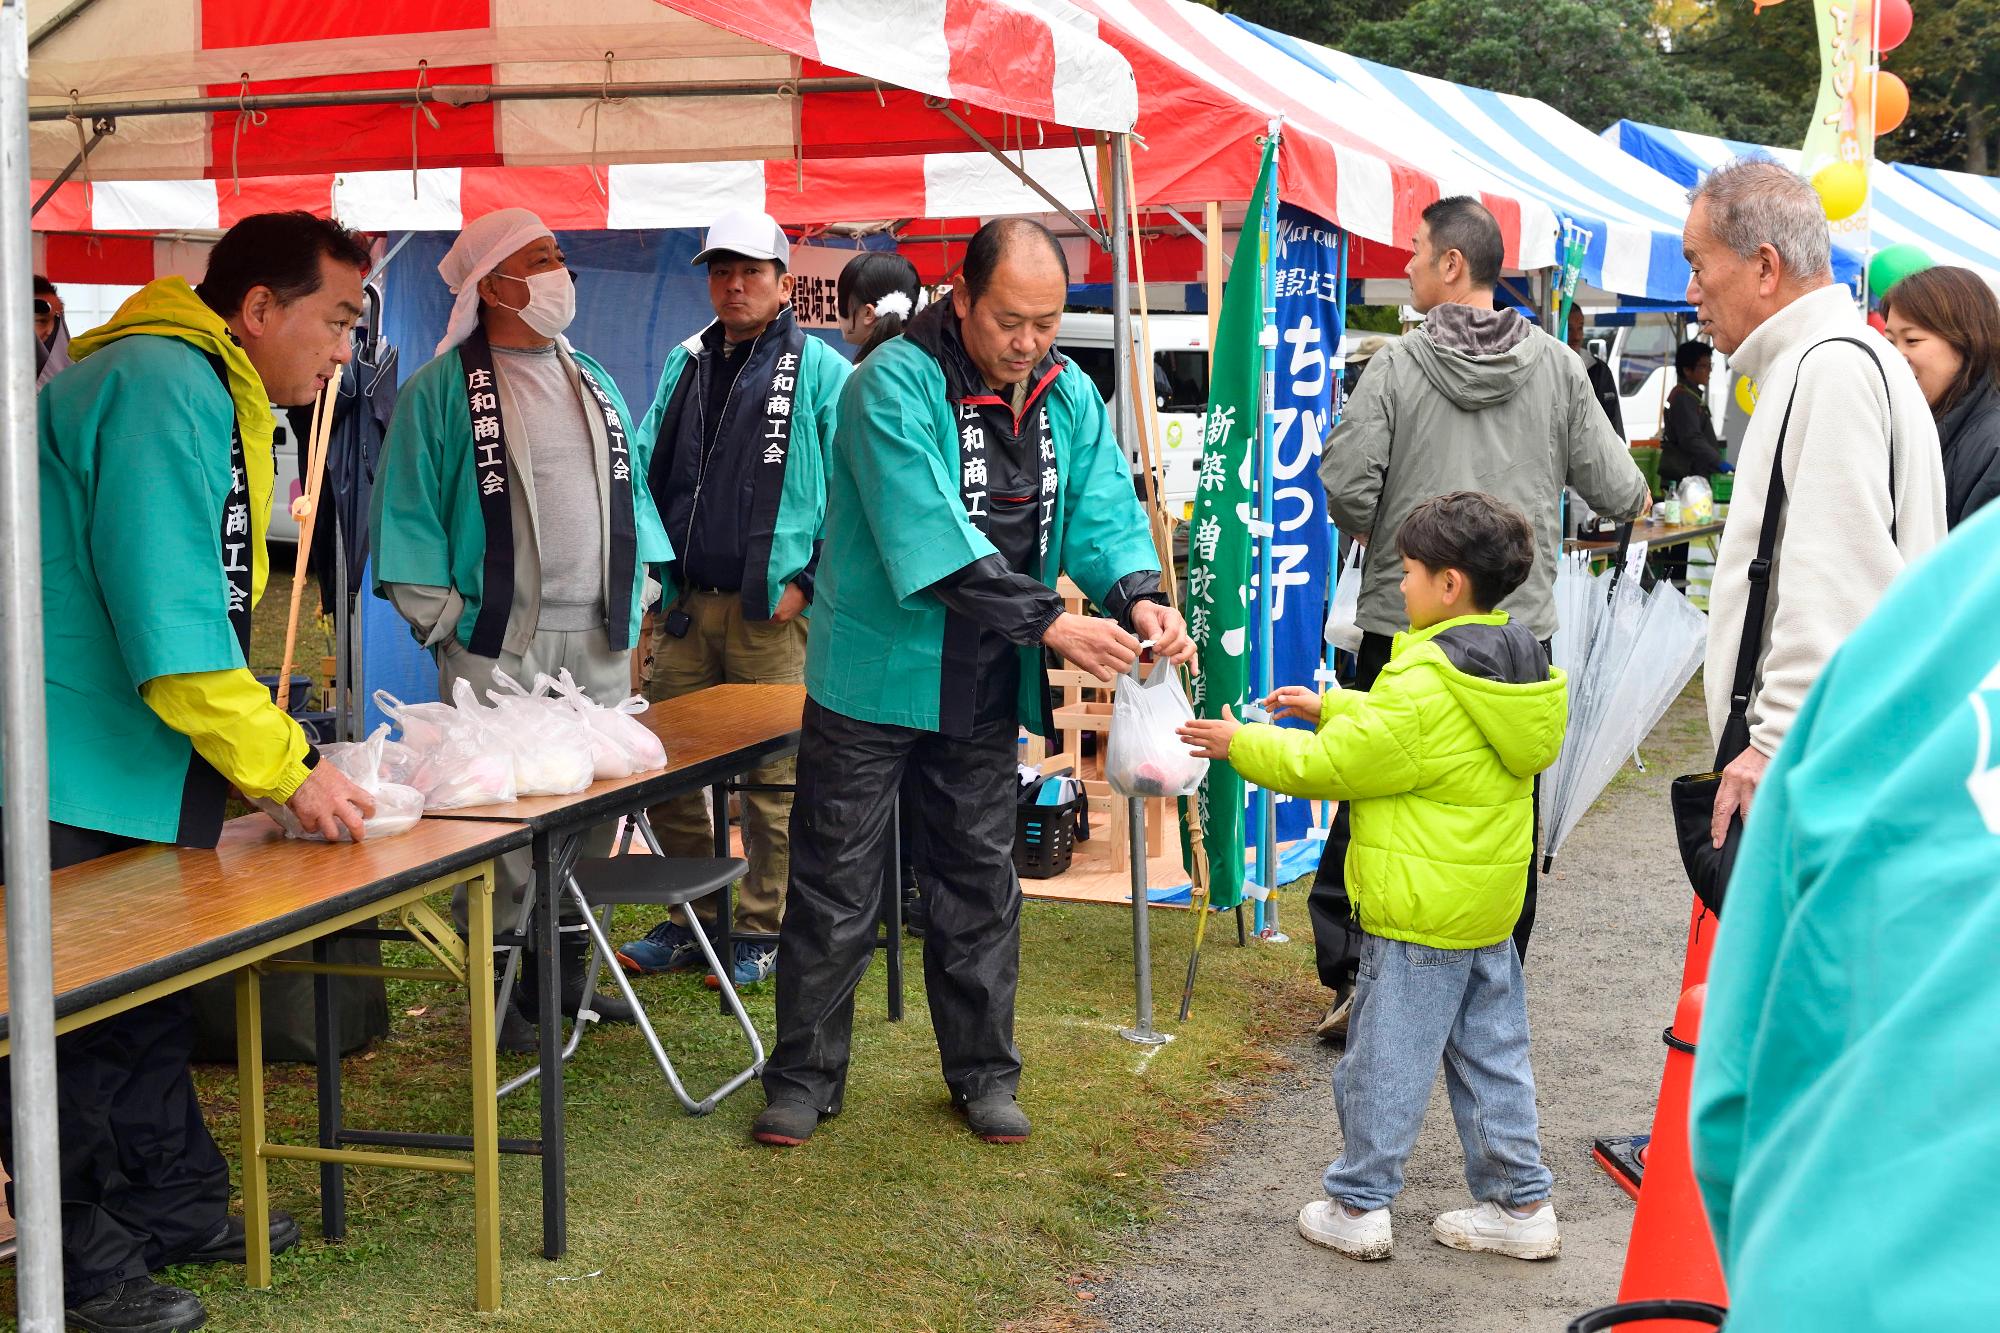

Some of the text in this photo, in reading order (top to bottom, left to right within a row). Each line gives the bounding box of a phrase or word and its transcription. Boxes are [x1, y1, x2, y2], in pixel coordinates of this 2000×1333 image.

[468, 368, 505, 496] 庄和商工会
[580, 367, 630, 482] 庄和商工会
[763, 352, 799, 464] 庄和商工会
[959, 402, 988, 537] 庄和商工
[223, 428, 249, 613] 和商工会
